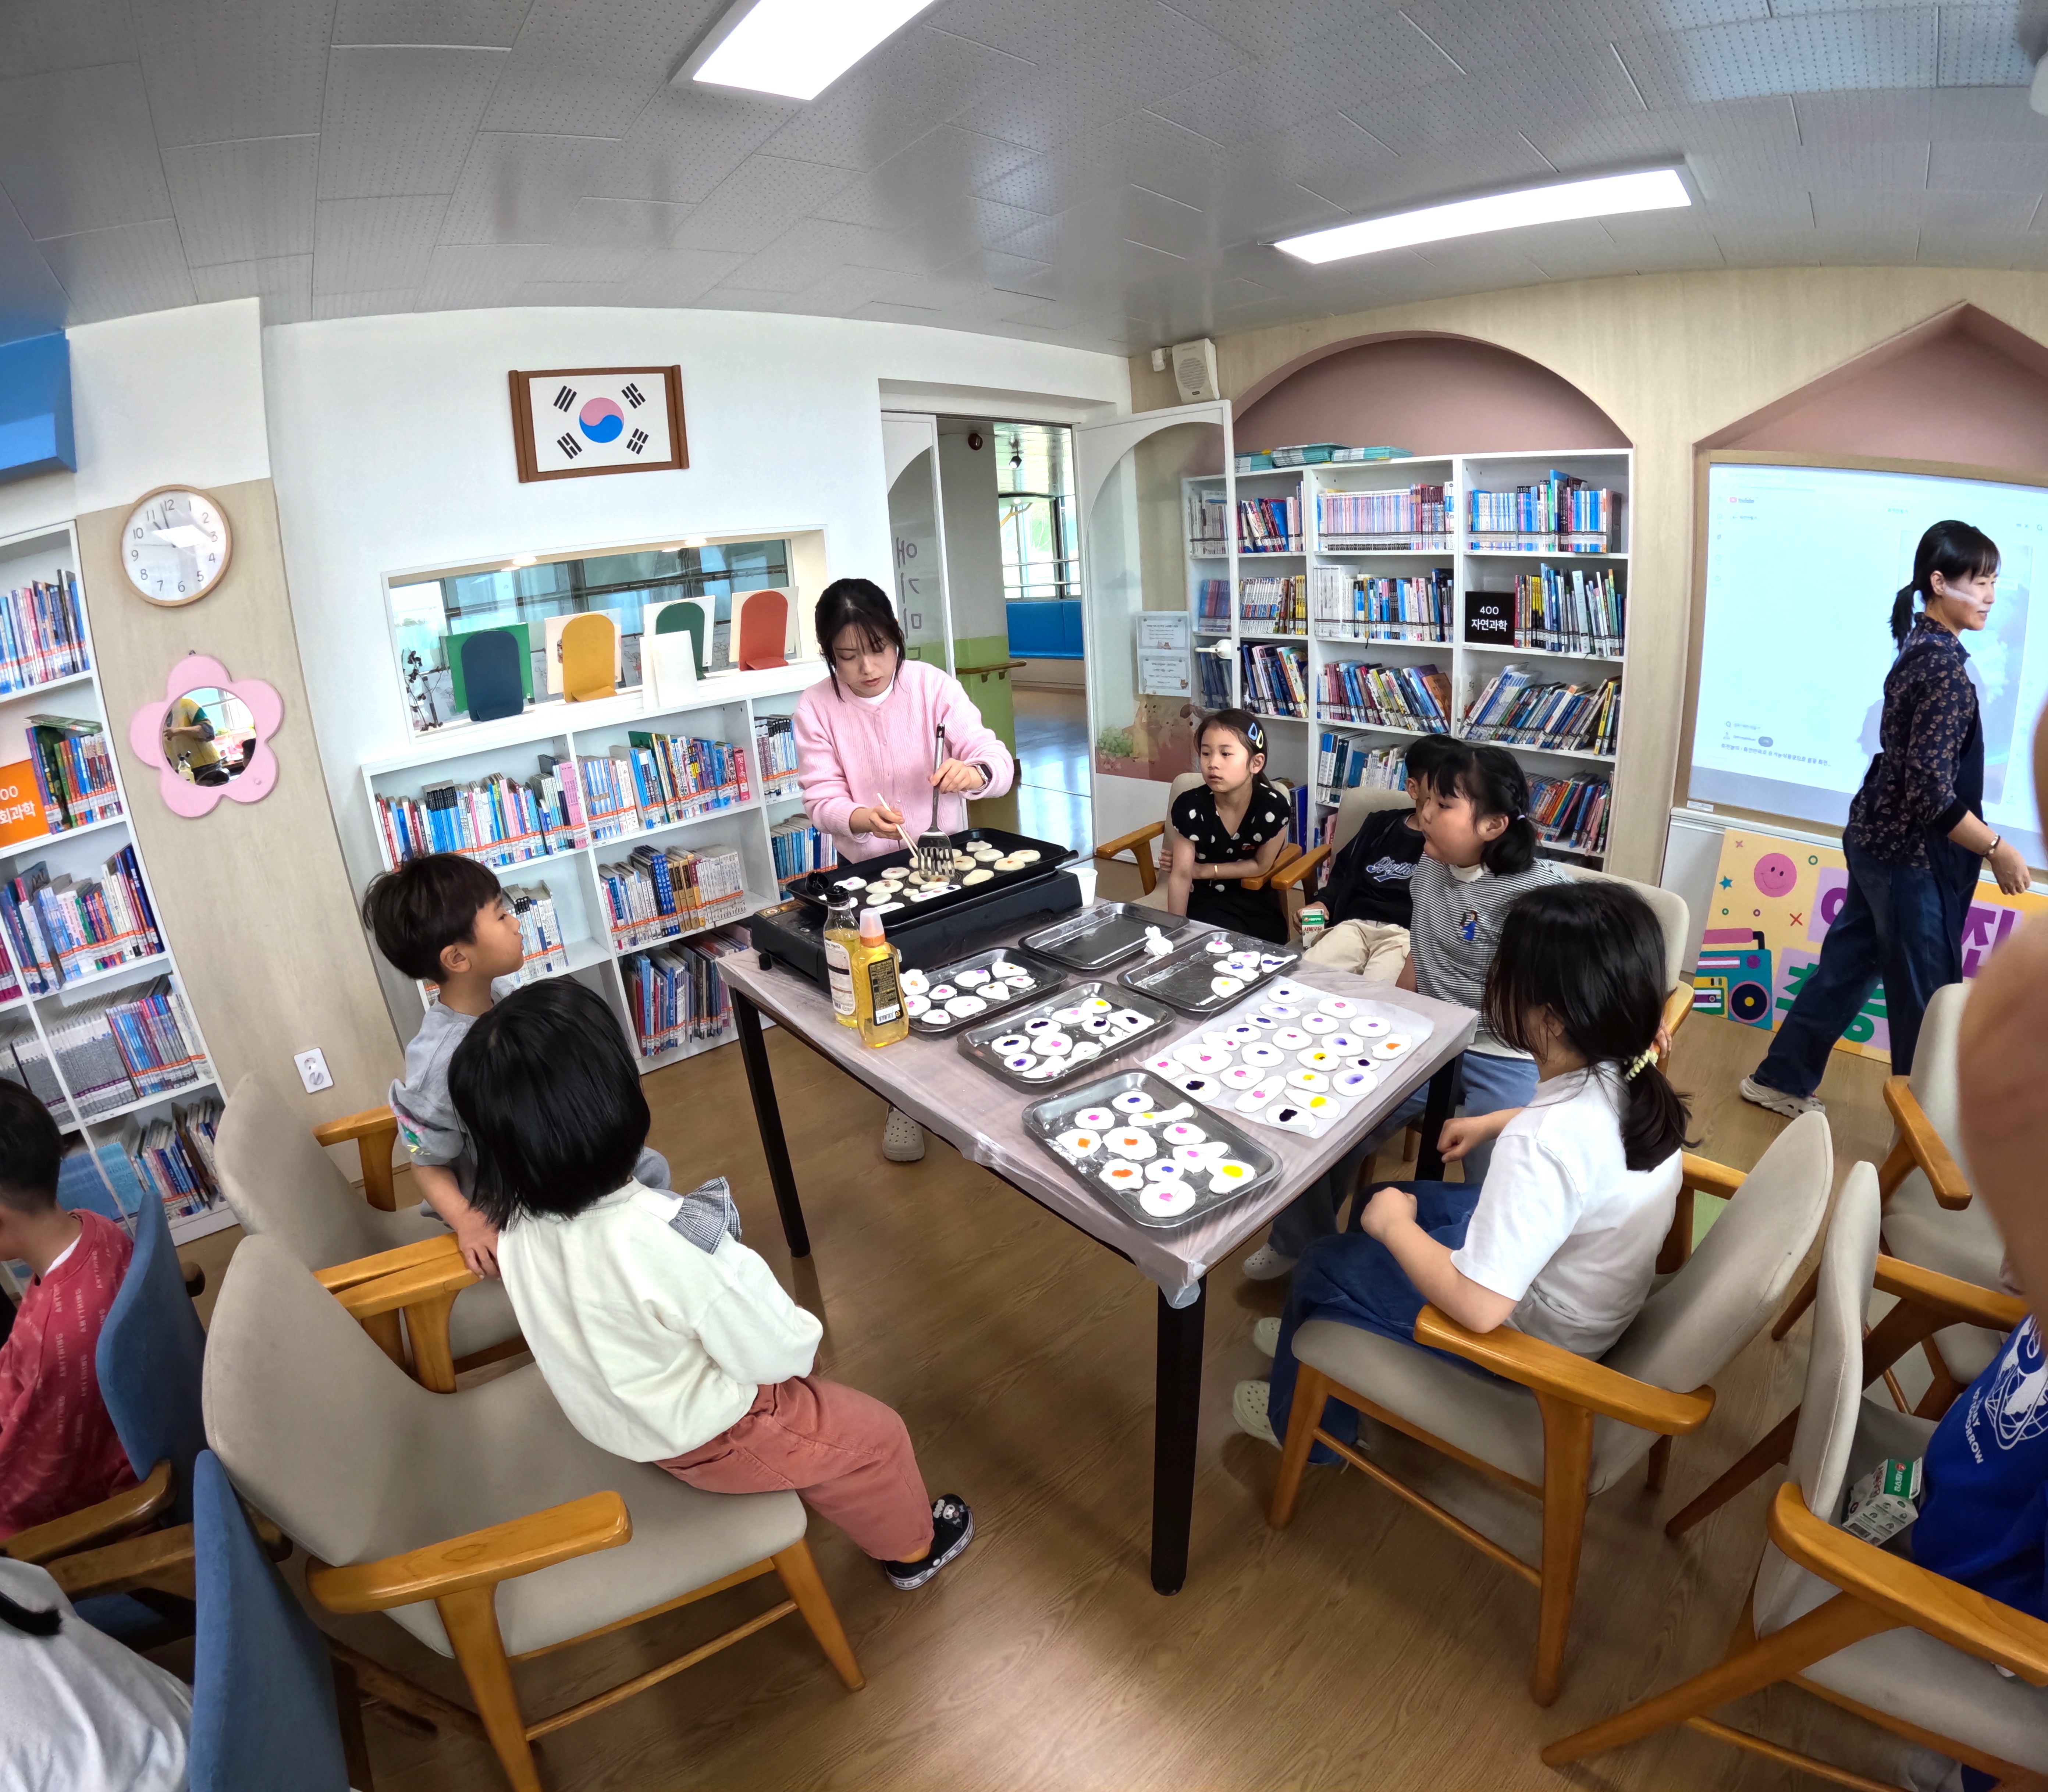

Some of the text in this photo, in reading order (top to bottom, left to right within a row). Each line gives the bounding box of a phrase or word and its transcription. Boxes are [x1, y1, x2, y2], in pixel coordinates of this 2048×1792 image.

[164, 499, 174, 511] 12
[189, 500, 192, 511] 1
[147, 509, 155, 521] 11
[202, 512, 209, 523] 2
[133, 527, 143, 539] 10
[210, 531, 218, 542] 3
[131, 550, 138, 561] 9
[209, 552, 215, 563] 4
[140, 569, 148, 580] 8
[197, 571, 204, 582] 5
[157, 580, 163, 591] 7
[178, 581, 185, 592] 6
[1480, 606, 1499, 615] 400
[1471, 619, 1508, 632] 자연과학
[0, 786, 18, 800] 00
[0, 800, 36, 824] 회과학
[75, 1288, 86, 1333] ANYTHING
[56, 1333, 66, 1377] ANYTHING
